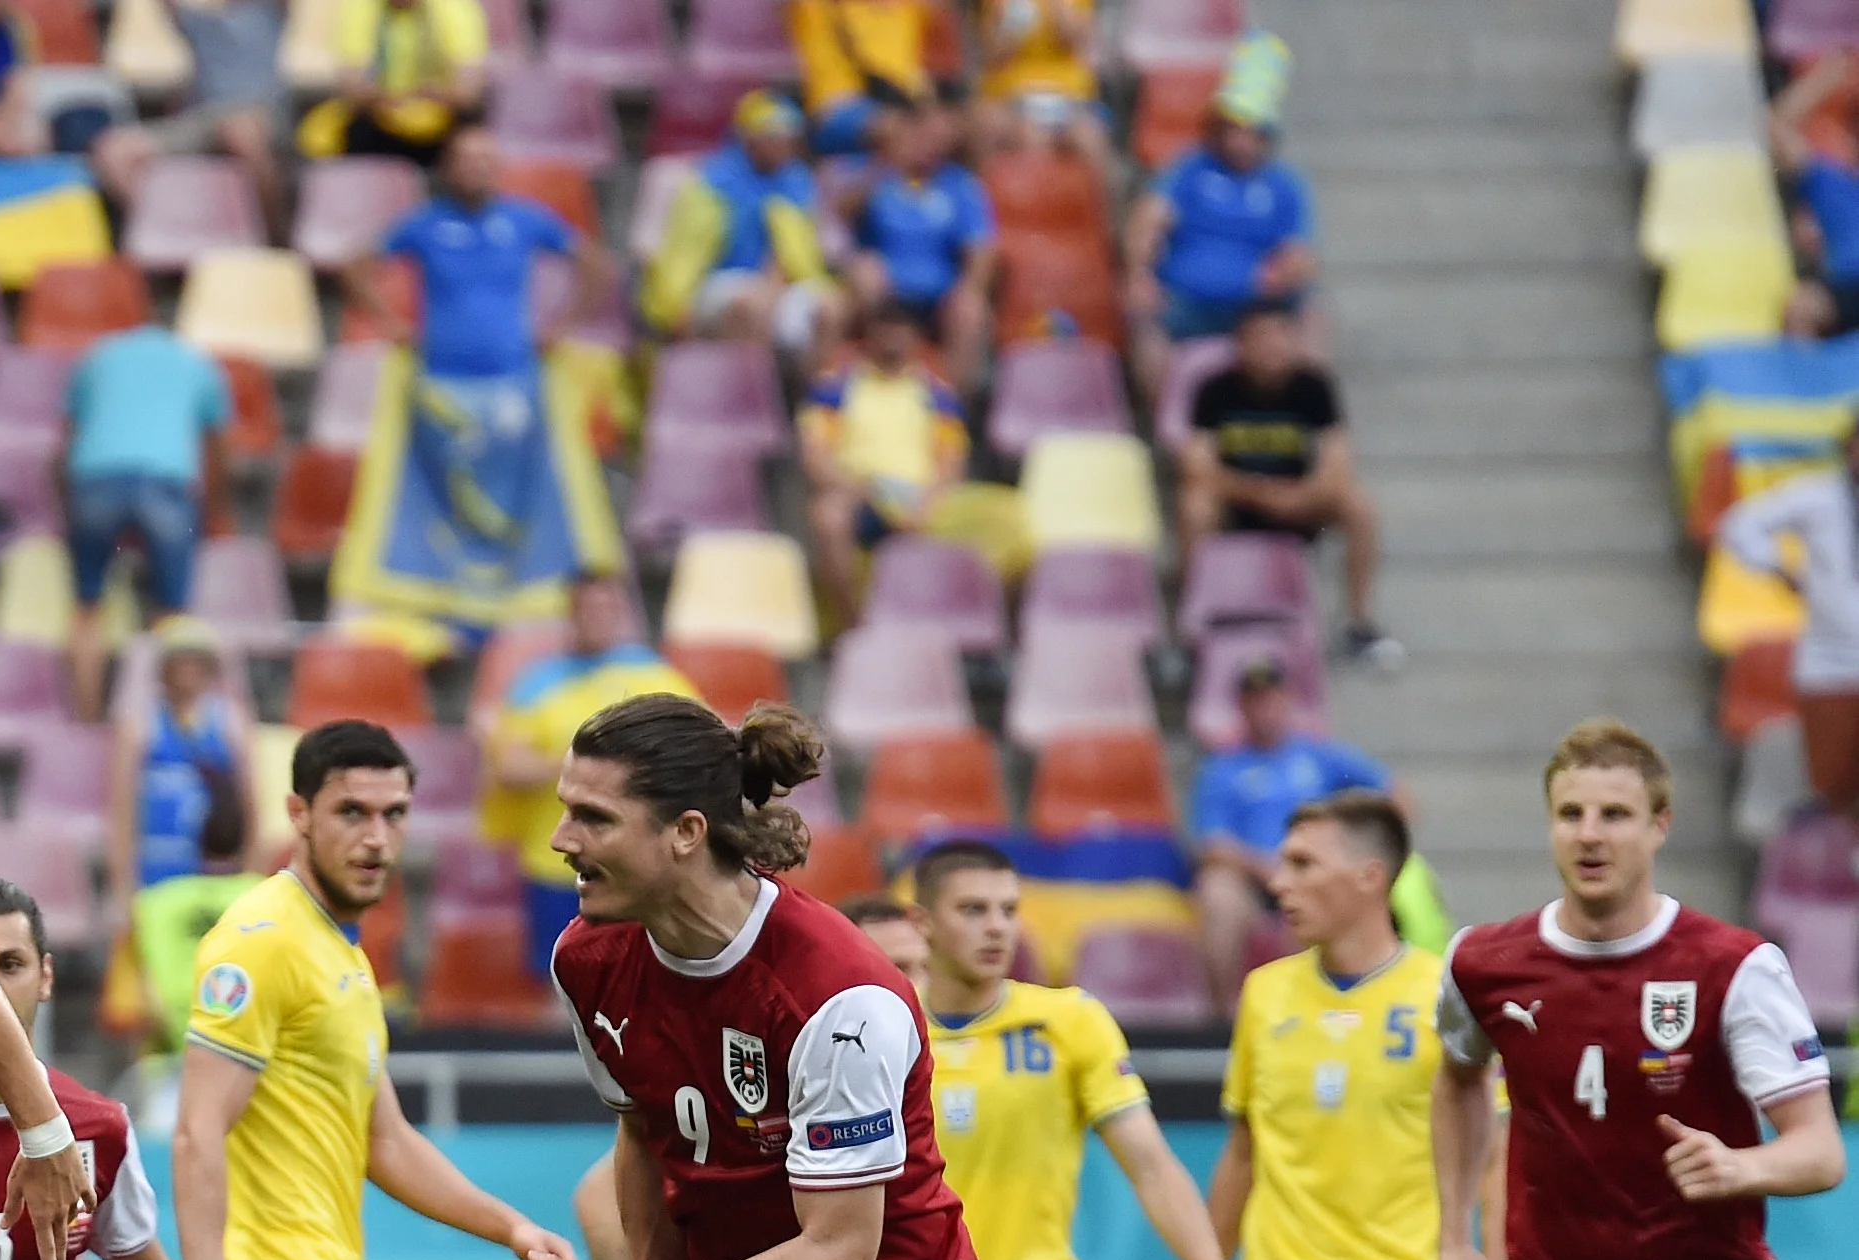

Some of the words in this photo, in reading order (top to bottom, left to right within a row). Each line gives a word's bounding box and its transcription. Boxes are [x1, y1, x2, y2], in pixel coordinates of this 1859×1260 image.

[1001, 1024, 1052, 1073] 16
[1384, 1006, 1417, 1060] 5
[1574, 1043, 1608, 1121] 4
[674, 1085, 710, 1165] 9
[833, 1115, 892, 1140] RESPECT
